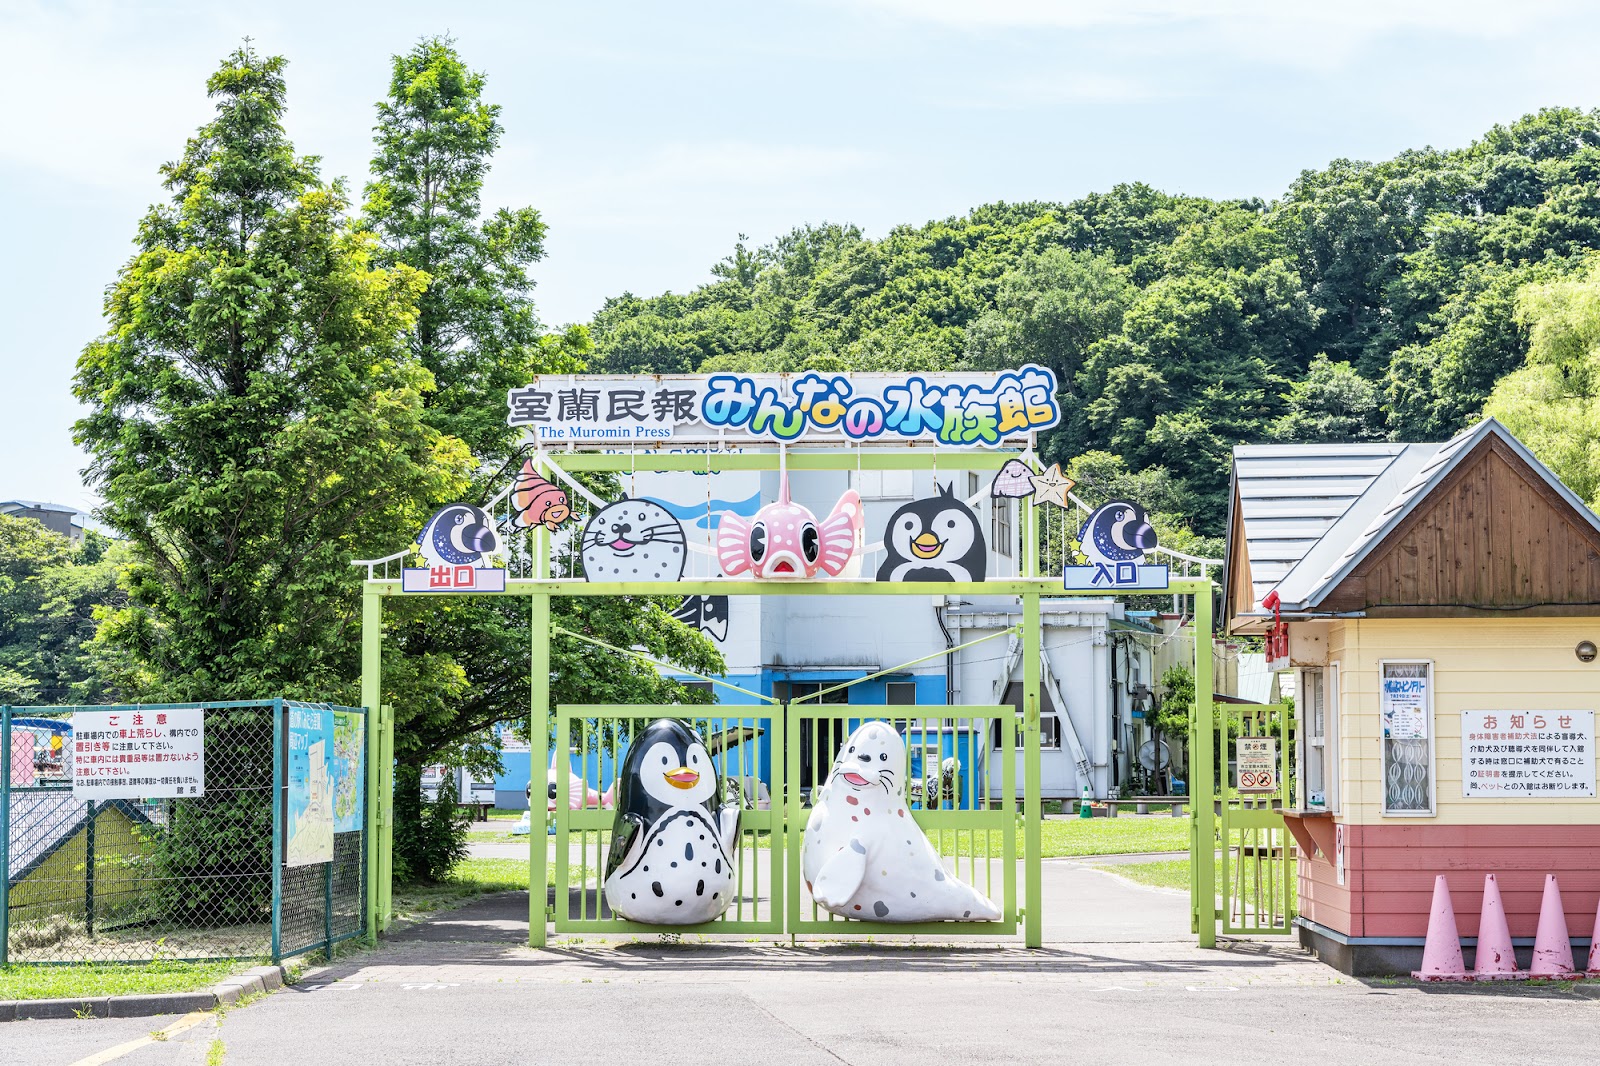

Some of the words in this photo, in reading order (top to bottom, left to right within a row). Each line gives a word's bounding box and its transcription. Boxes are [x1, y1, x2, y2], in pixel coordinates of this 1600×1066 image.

[511, 388, 698, 423] 室蘭民報
[704, 367, 1058, 445] みんなの水族館
[539, 426, 565, 438] The
[569, 426, 630, 438] Muromin
[636, 426, 670, 438] Press
[430, 565, 474, 588] 出口
[1090, 562, 1137, 585] 入口
[109, 713, 167, 726] ご注意
[1483, 715, 1572, 729] お知らせ
[1469, 732, 1588, 740] 身体障害者補助犬法による盲導犬、
[1470, 745, 1585, 753] 介助犬及び聴導犬を同伴して入館
[1470, 757, 1585, 765] する時は窓口に補助犬で有ること
[76, 767, 130, 777] 注意して下さい。
[1470, 770, 1574, 778] の証明書を提示してください。
[1470, 782, 1589, 790] 尚、ペットとの入館はお断りします。
